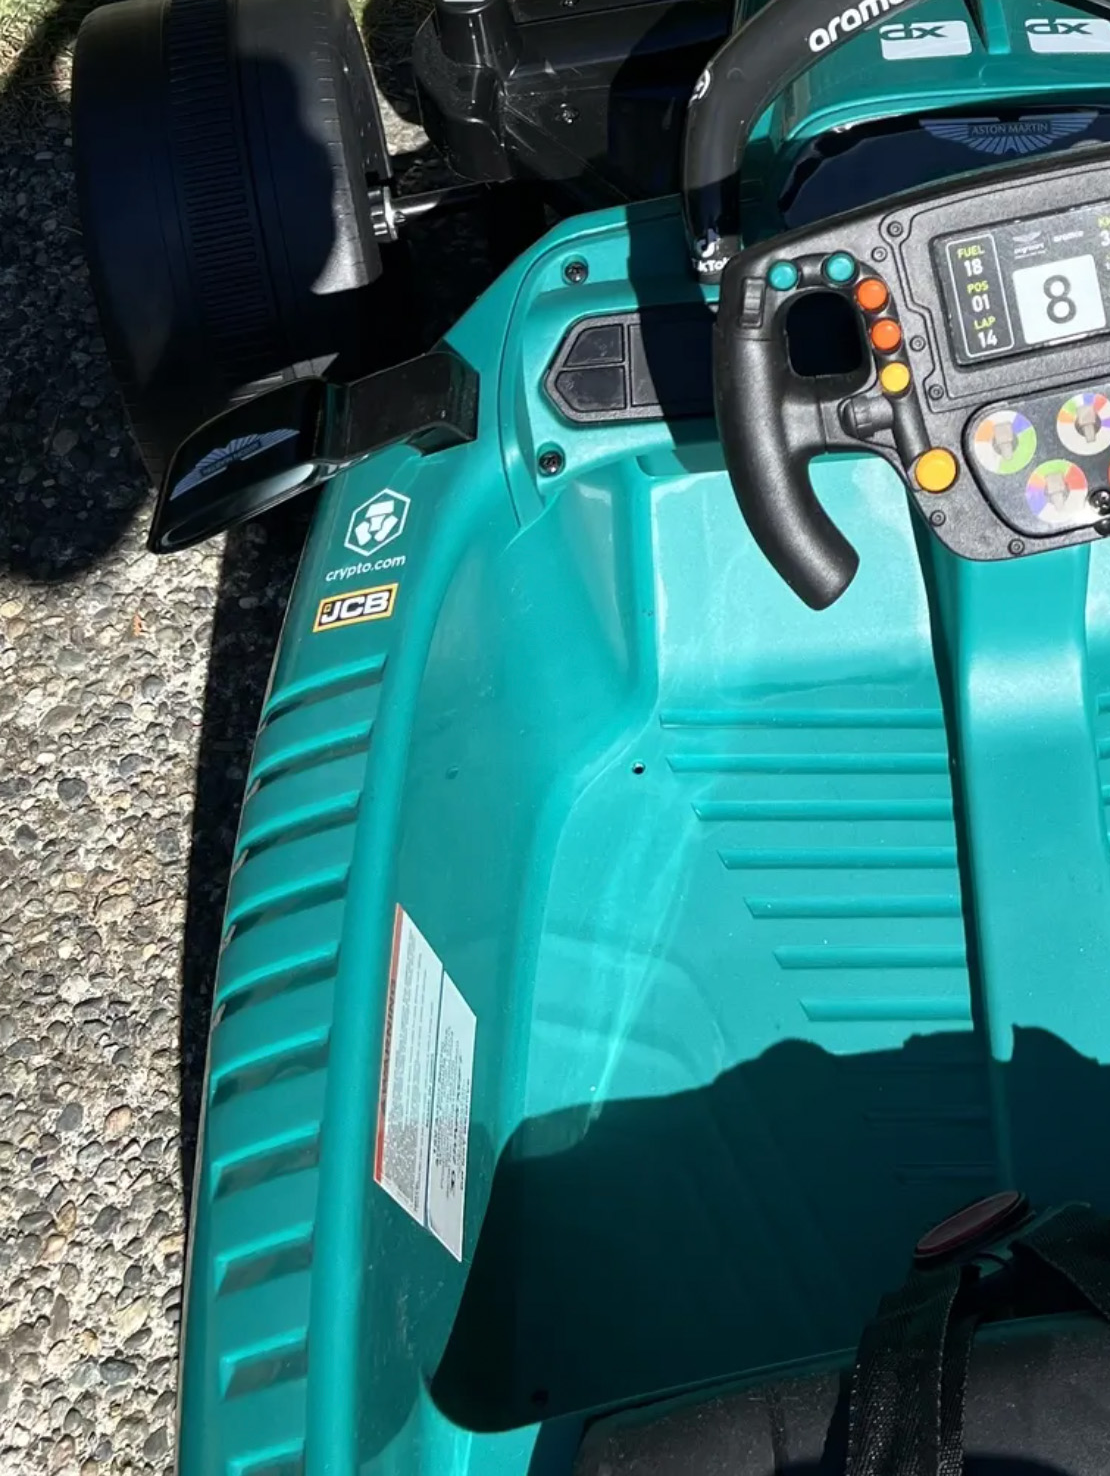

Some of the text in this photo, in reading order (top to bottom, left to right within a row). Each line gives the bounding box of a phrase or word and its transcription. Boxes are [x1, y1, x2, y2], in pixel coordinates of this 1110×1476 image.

[971, 122, 1048, 136] ASTON MARTIN
[957, 245, 985, 258] FUEL
[964, 258, 983, 276] 18
[967, 280, 989, 294] POS
[972, 293, 990, 312] 01
[1043, 274, 1077, 324] 8
[974, 315, 996, 329] LAP
[978, 329, 998, 348] 14
[325, 552, 407, 583] crypto.com
[320, 592, 390, 625] JCB
